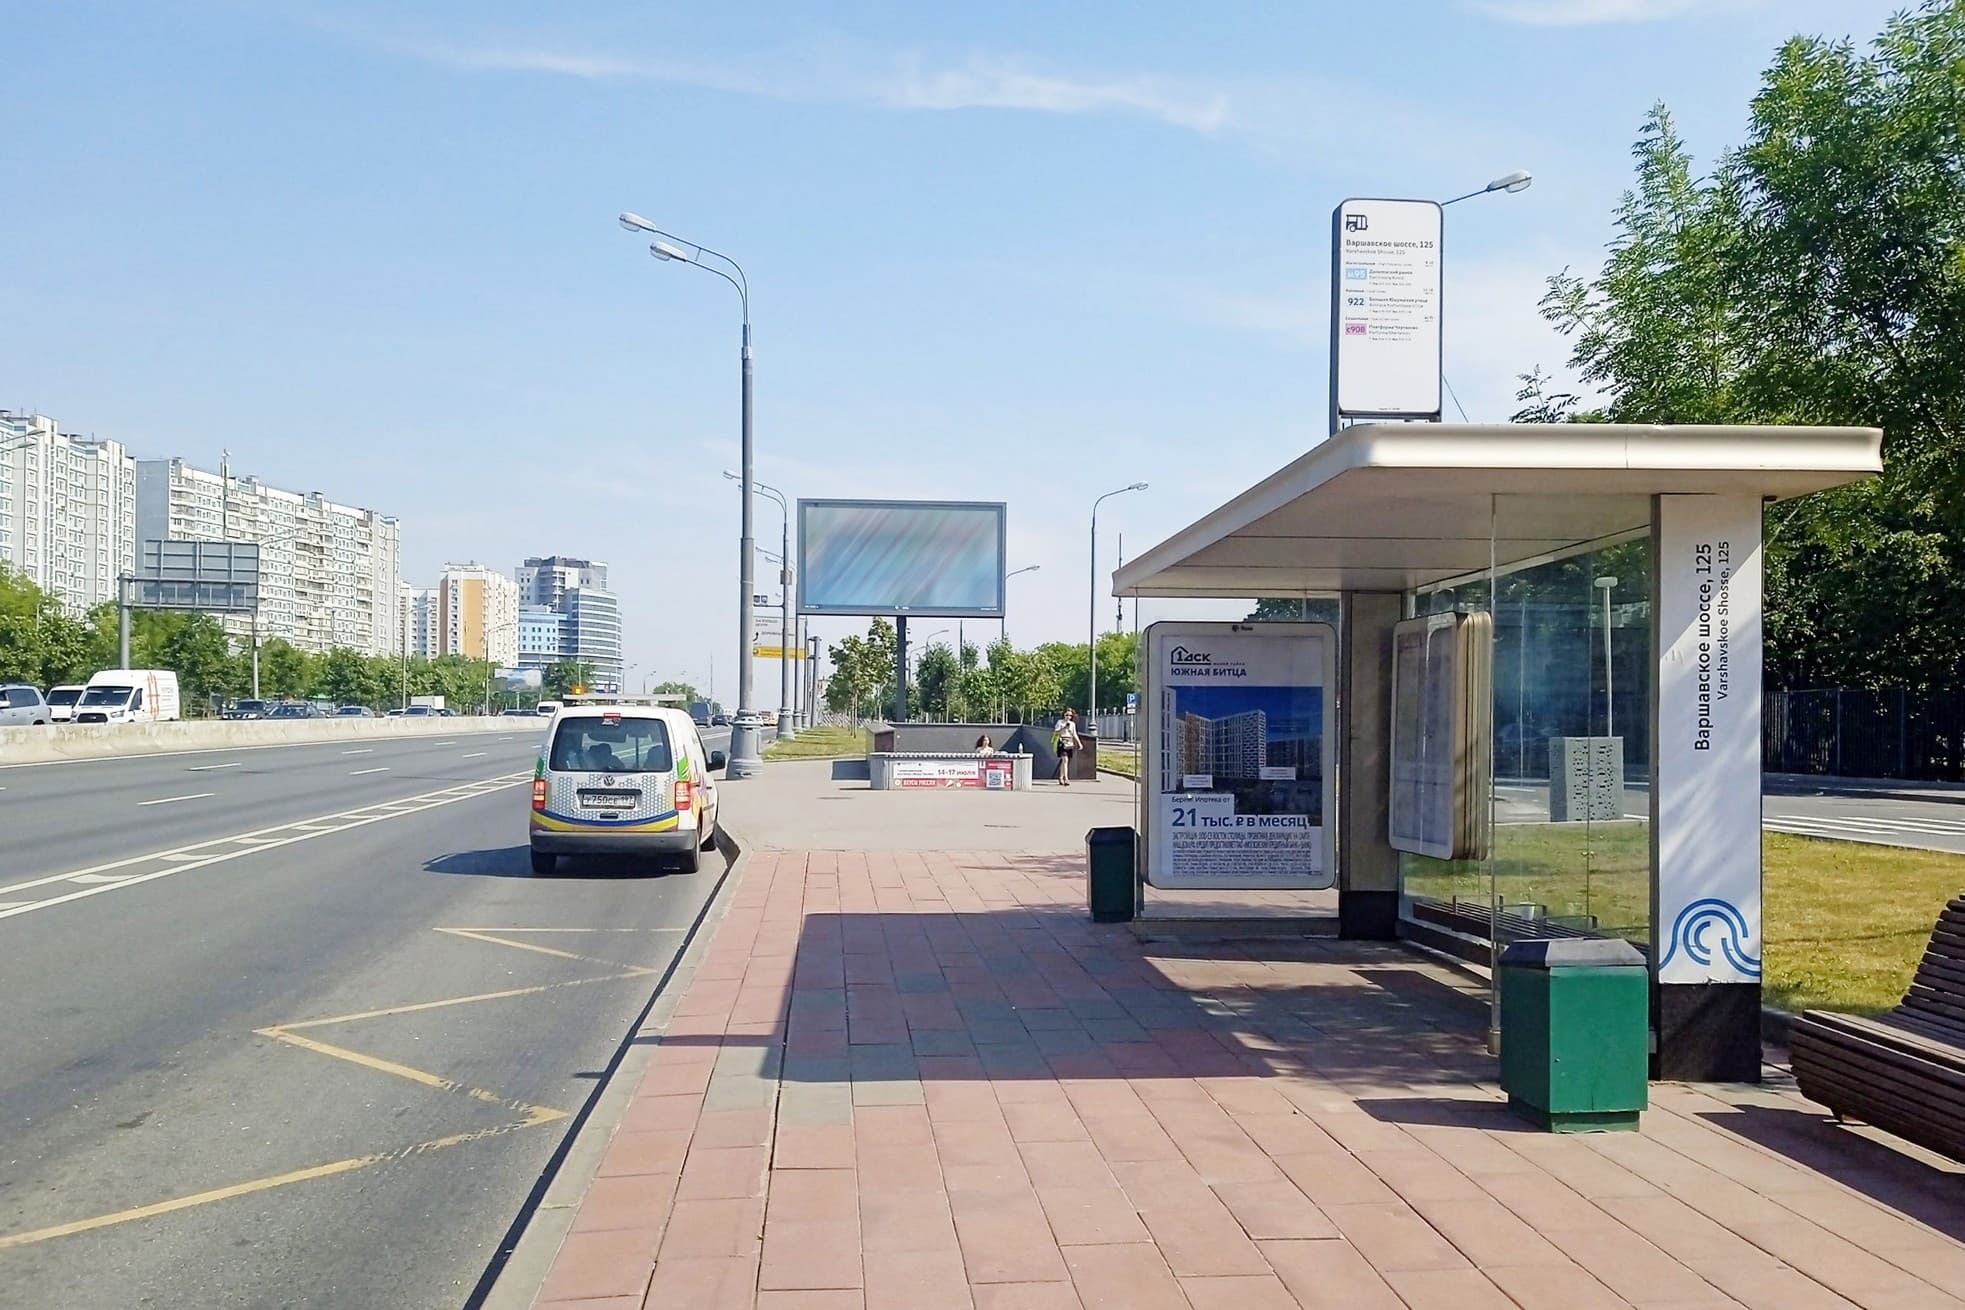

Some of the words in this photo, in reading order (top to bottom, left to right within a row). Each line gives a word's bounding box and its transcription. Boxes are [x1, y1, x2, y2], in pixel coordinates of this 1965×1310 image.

[1348, 298, 1364, 306] 922
[1696, 544, 1711, 574] 125
[1719, 541, 1729, 564] 125
[1718, 567, 1731, 615] Shosse,
[1699, 578, 1714, 637] шоссе,
[1171, 668, 1210, 676] ЮЖНАЯ
[1213, 668, 1247, 678] БИТЦА
[1717, 620, 1729, 700] Varshavskoe
[1695, 643, 1713, 750] Варшавское
[1172, 808, 1196, 826] 21
[1201, 817, 1232, 827] тыс.
[1247, 817, 1255, 826] в
[1259, 817, 1307, 829] месяц
